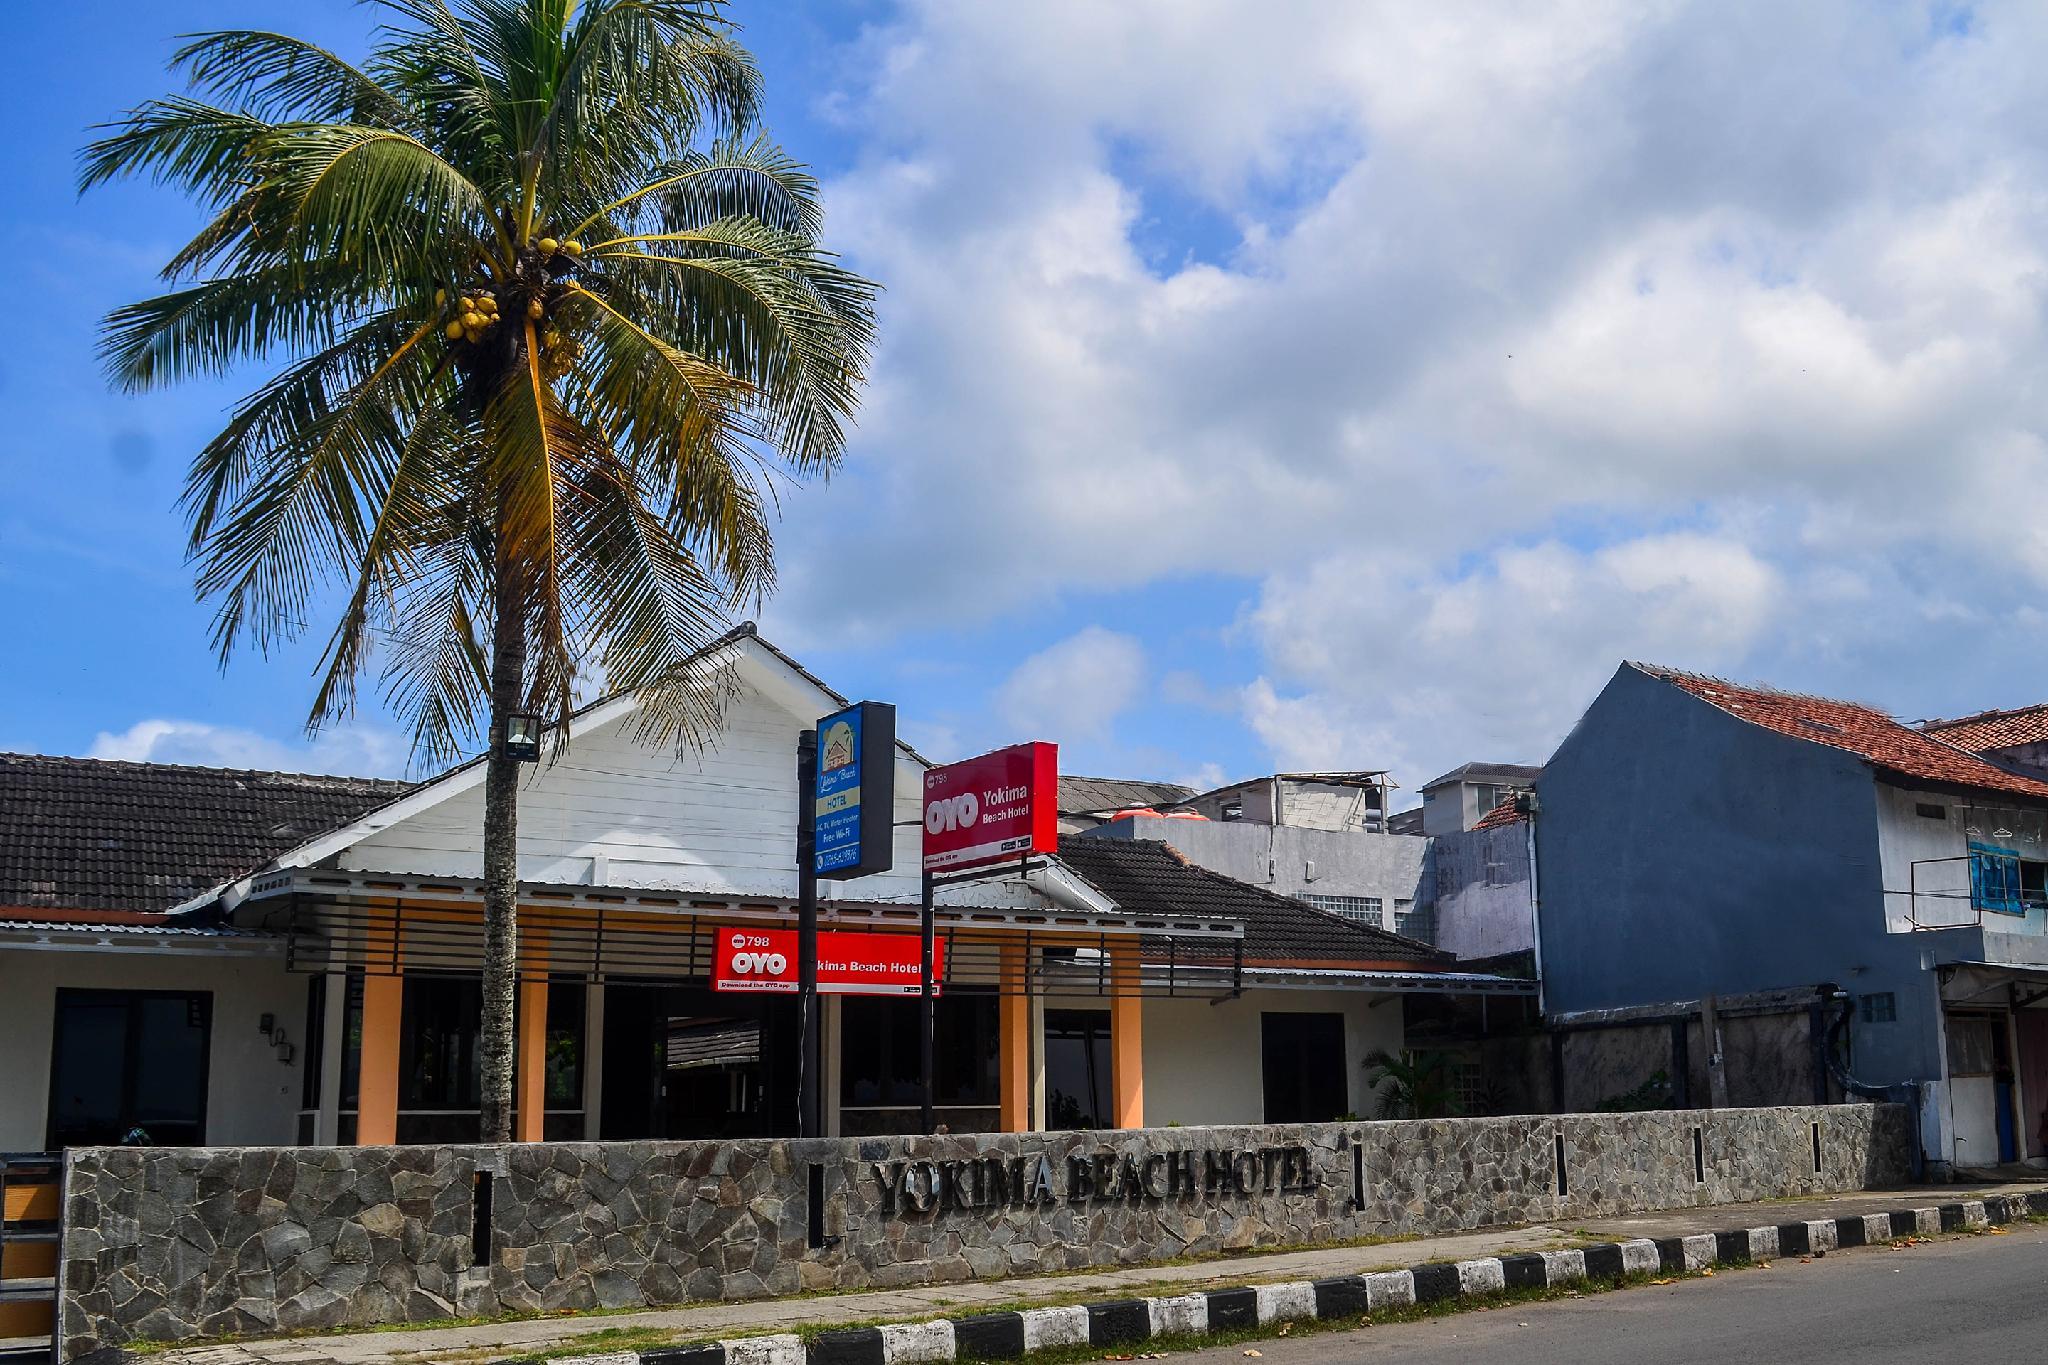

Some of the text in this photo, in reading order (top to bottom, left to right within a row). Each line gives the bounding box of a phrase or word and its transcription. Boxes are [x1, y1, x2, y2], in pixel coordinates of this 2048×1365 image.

[827, 794, 847, 809] HOTEL
[983, 785, 1027, 807] Yokima
[926, 792, 978, 835] OYO
[983, 804, 1029, 824] Beach Hotel
[823, 834, 835, 843] Free
[746, 936, 770, 947] 798
[731, 952, 787, 974] OYO
[817, 959, 922, 974] kima Beach Hotel
[870, 1147, 1320, 1214] YOKIMA BEACH HOTEL
